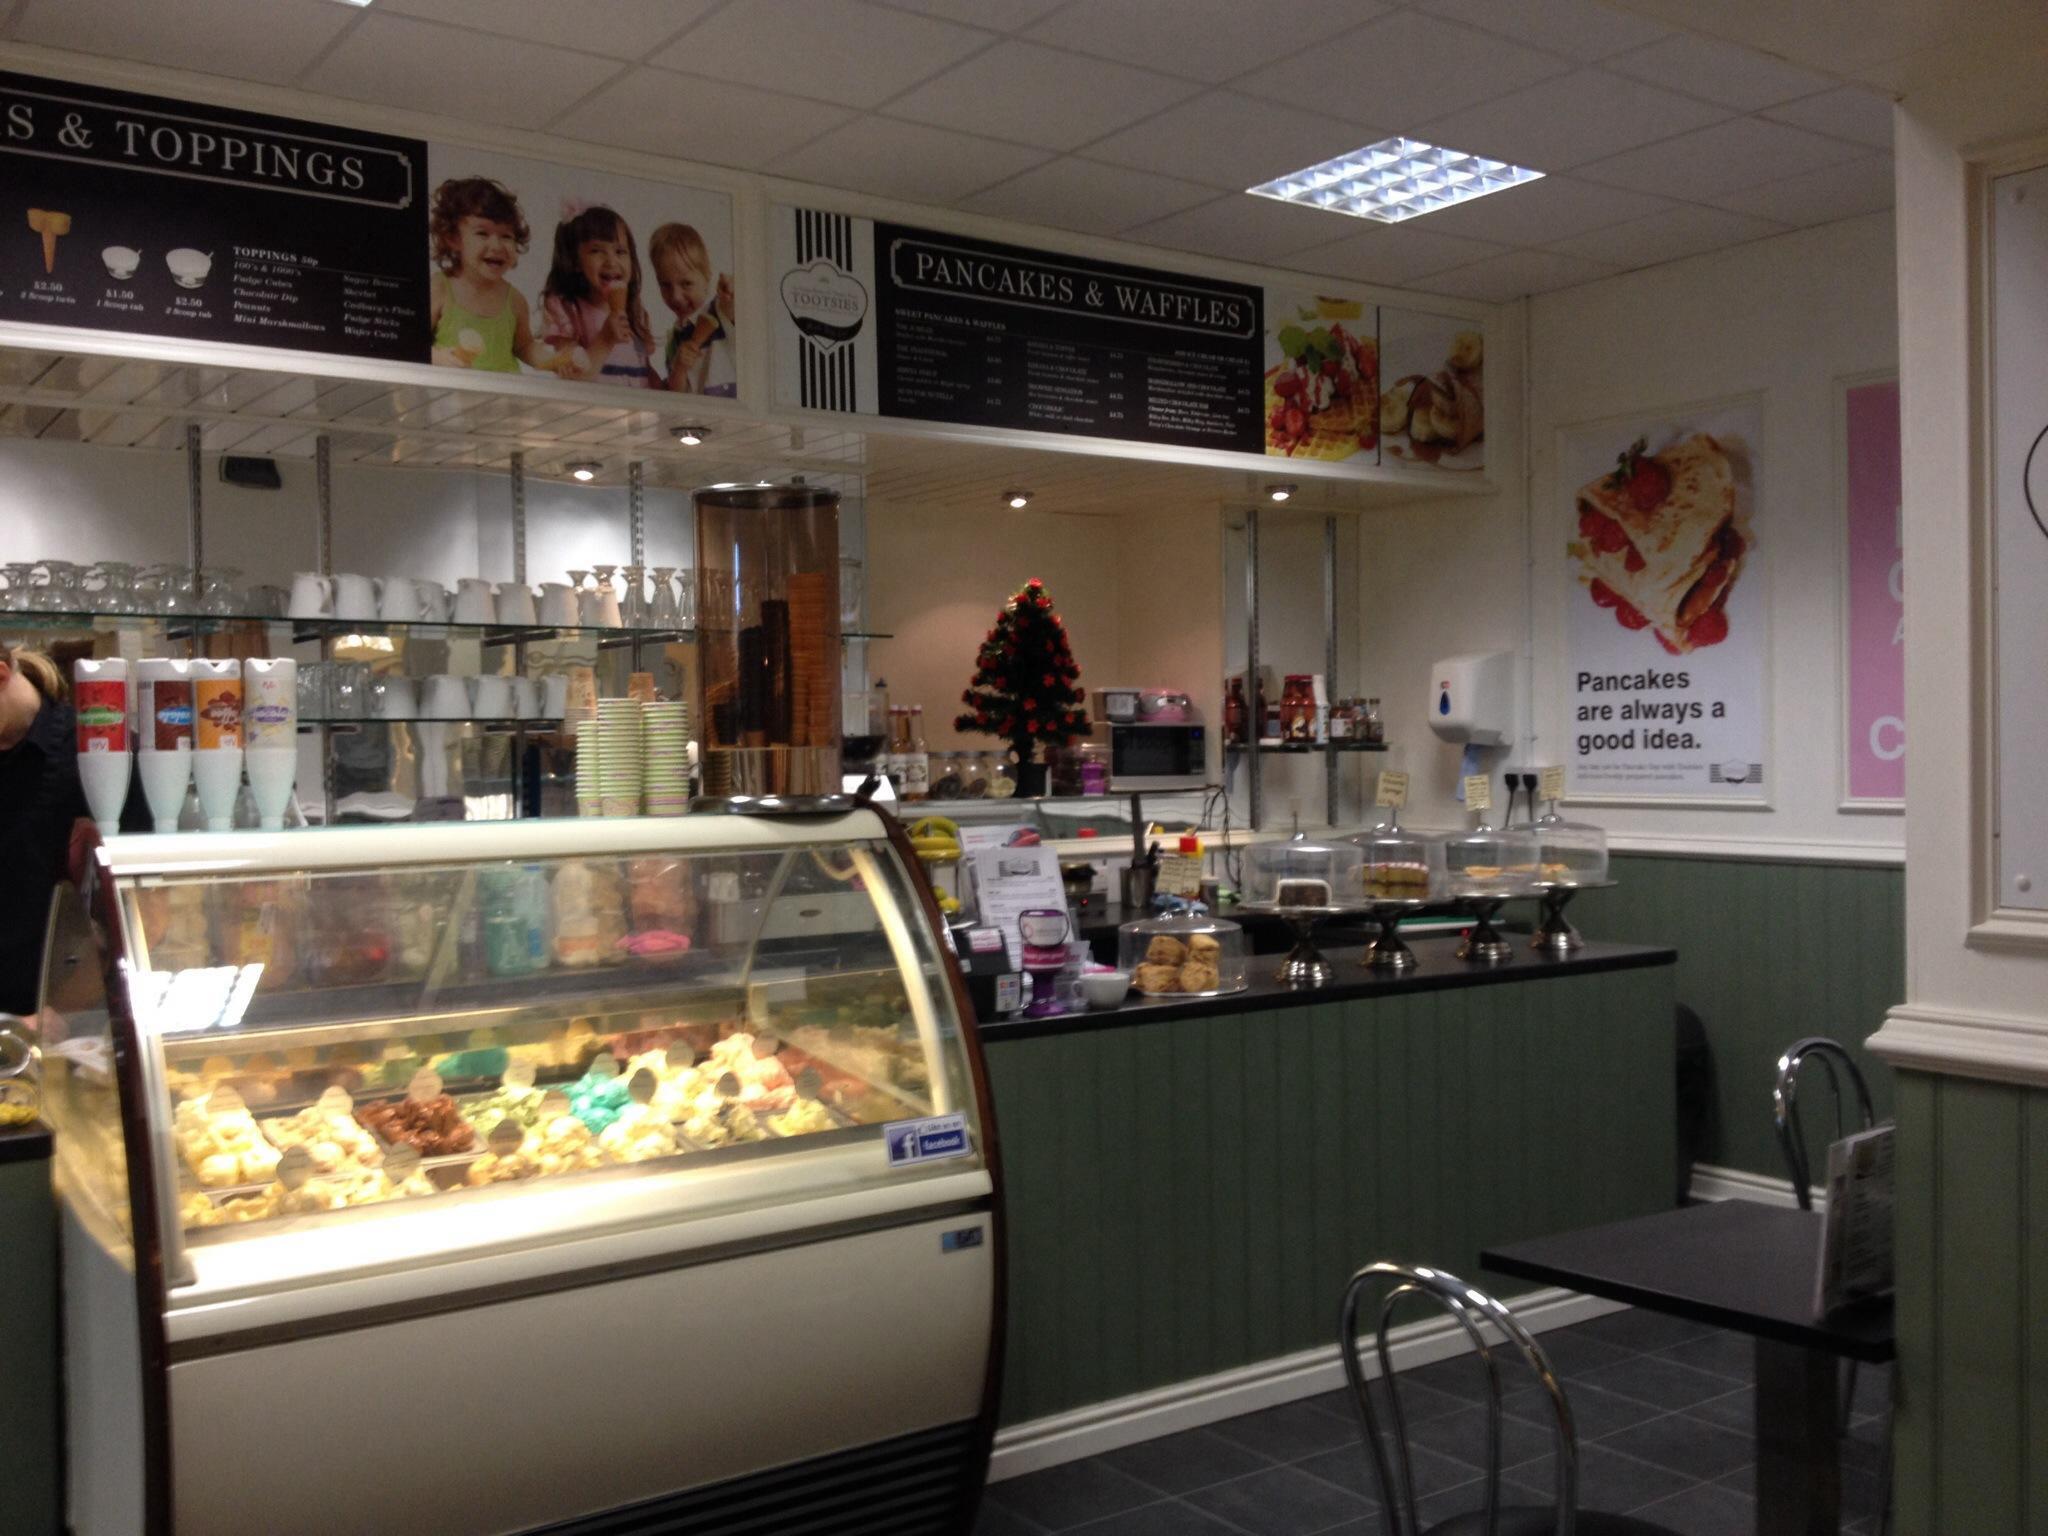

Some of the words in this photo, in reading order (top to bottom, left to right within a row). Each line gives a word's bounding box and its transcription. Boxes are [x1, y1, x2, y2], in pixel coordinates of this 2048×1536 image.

[57, 111, 94, 149] &
[115, 120, 364, 190] TOPPINGS
[233, 246, 297, 263] TOPPINGS
[301, 255, 319, 267] 50p
[233, 274, 262, 286] Fudge
[914, 251, 1074, 304] PANCAKES
[1084, 279, 1105, 308] &
[1115, 284, 1241, 328] WAFFLES
[234, 288, 279, 301] Chocolate
[281, 292, 299, 304] Dip
[792, 292, 859, 312] TOOTSIES
[234, 300, 271, 313] Peanuts
[234, 314, 256, 325] Mini
[923, 311, 964, 325] PANCAKES
[1577, 669, 1690, 692] Pancakes
[1577, 704, 1613, 721] are
[1621, 699, 1703, 725] always
[1712, 701, 1726, 718] a
[1577, 729, 1635, 756] good
[1643, 728, 1702, 750] idea.
[922, 1135, 960, 1151] facebook
